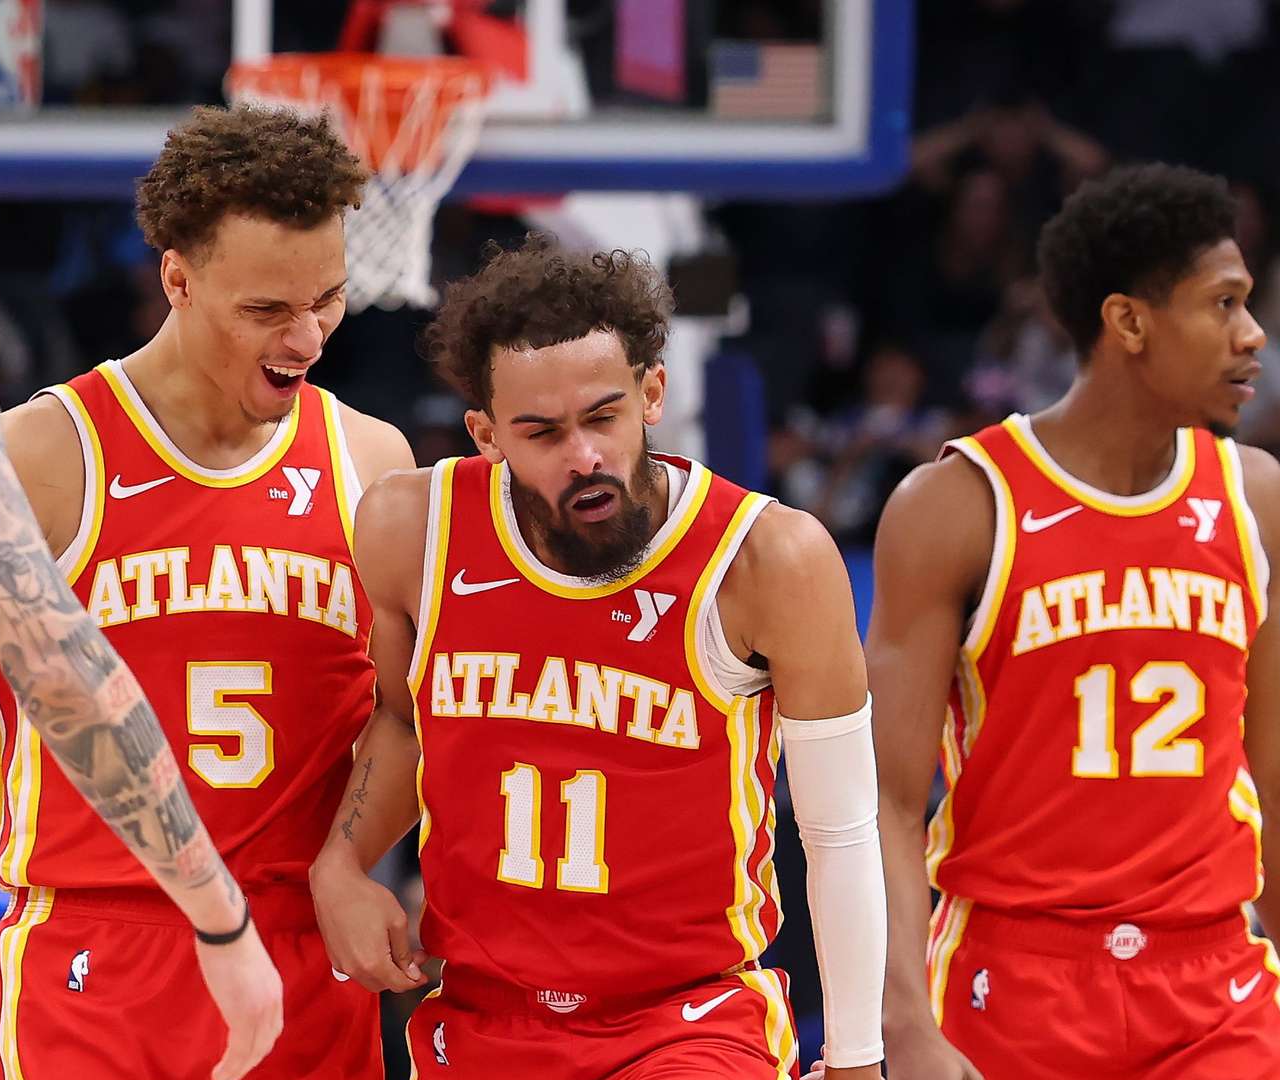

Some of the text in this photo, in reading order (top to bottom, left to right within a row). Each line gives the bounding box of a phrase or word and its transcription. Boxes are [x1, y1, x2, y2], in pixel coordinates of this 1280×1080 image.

[269, 487, 288, 499] the
[87, 544, 358, 640] ATLANTA
[611, 609, 631, 623] the
[1011, 567, 1249, 657] ATLANTA
[186, 661, 275, 789] 5
[431, 651, 701, 750] ATLANTA
[1072, 660, 1206, 779] 12
[496, 761, 609, 894] 11
